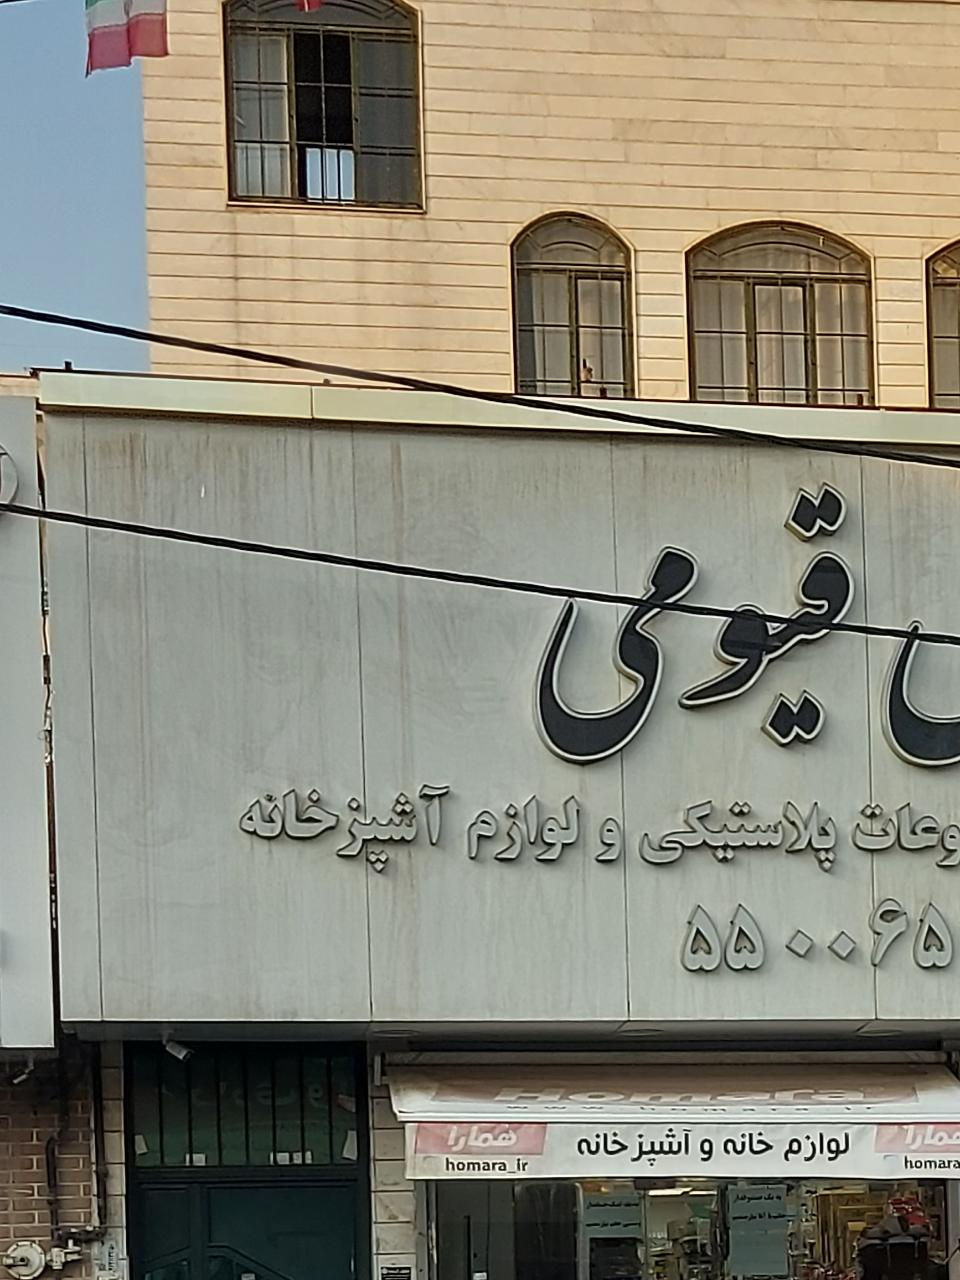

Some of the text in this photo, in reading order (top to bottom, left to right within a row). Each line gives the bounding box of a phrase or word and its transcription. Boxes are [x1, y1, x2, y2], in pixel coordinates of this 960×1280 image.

[535, 482, 855, 766] قیومی
[239, 784, 450, 872] آشپزخانه
[466, 794, 580, 862] لوازم
[595, 814, 623, 862] و
[639, 800, 837, 872] پلاستیکی
[445, 1156, 529, 1174] homara_ir
[447, 1125, 518, 1151] همارا
[576, 1128, 850, 1167] لوازم خانه و آشپزخانه
